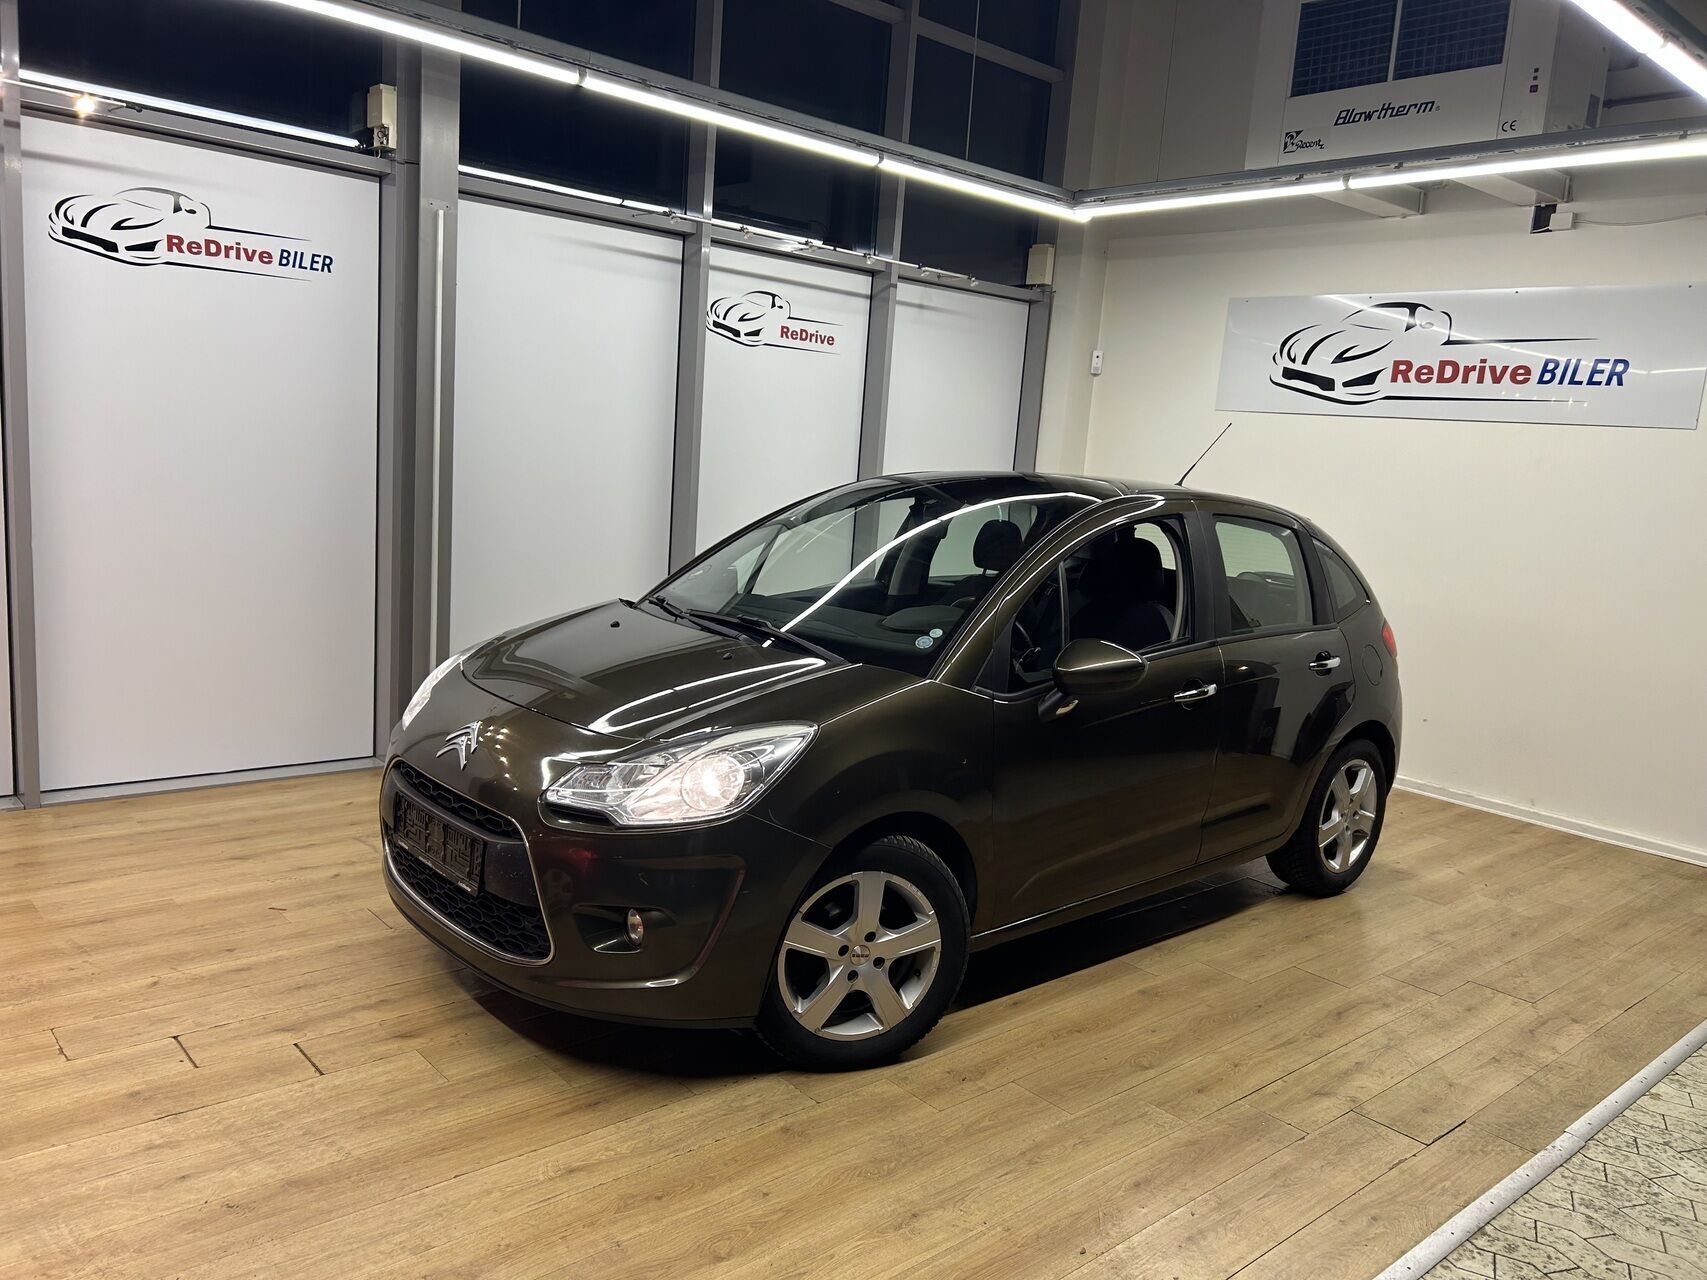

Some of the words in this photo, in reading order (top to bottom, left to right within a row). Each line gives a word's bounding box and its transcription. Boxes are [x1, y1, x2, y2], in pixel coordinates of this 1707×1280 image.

[166, 234, 274, 265] ReDrive
[278, 248, 334, 273] BILER
[780, 325, 835, 346] ReDrive
[1390, 358, 1532, 385] ReDrive
[1536, 358, 1630, 387] BILER
